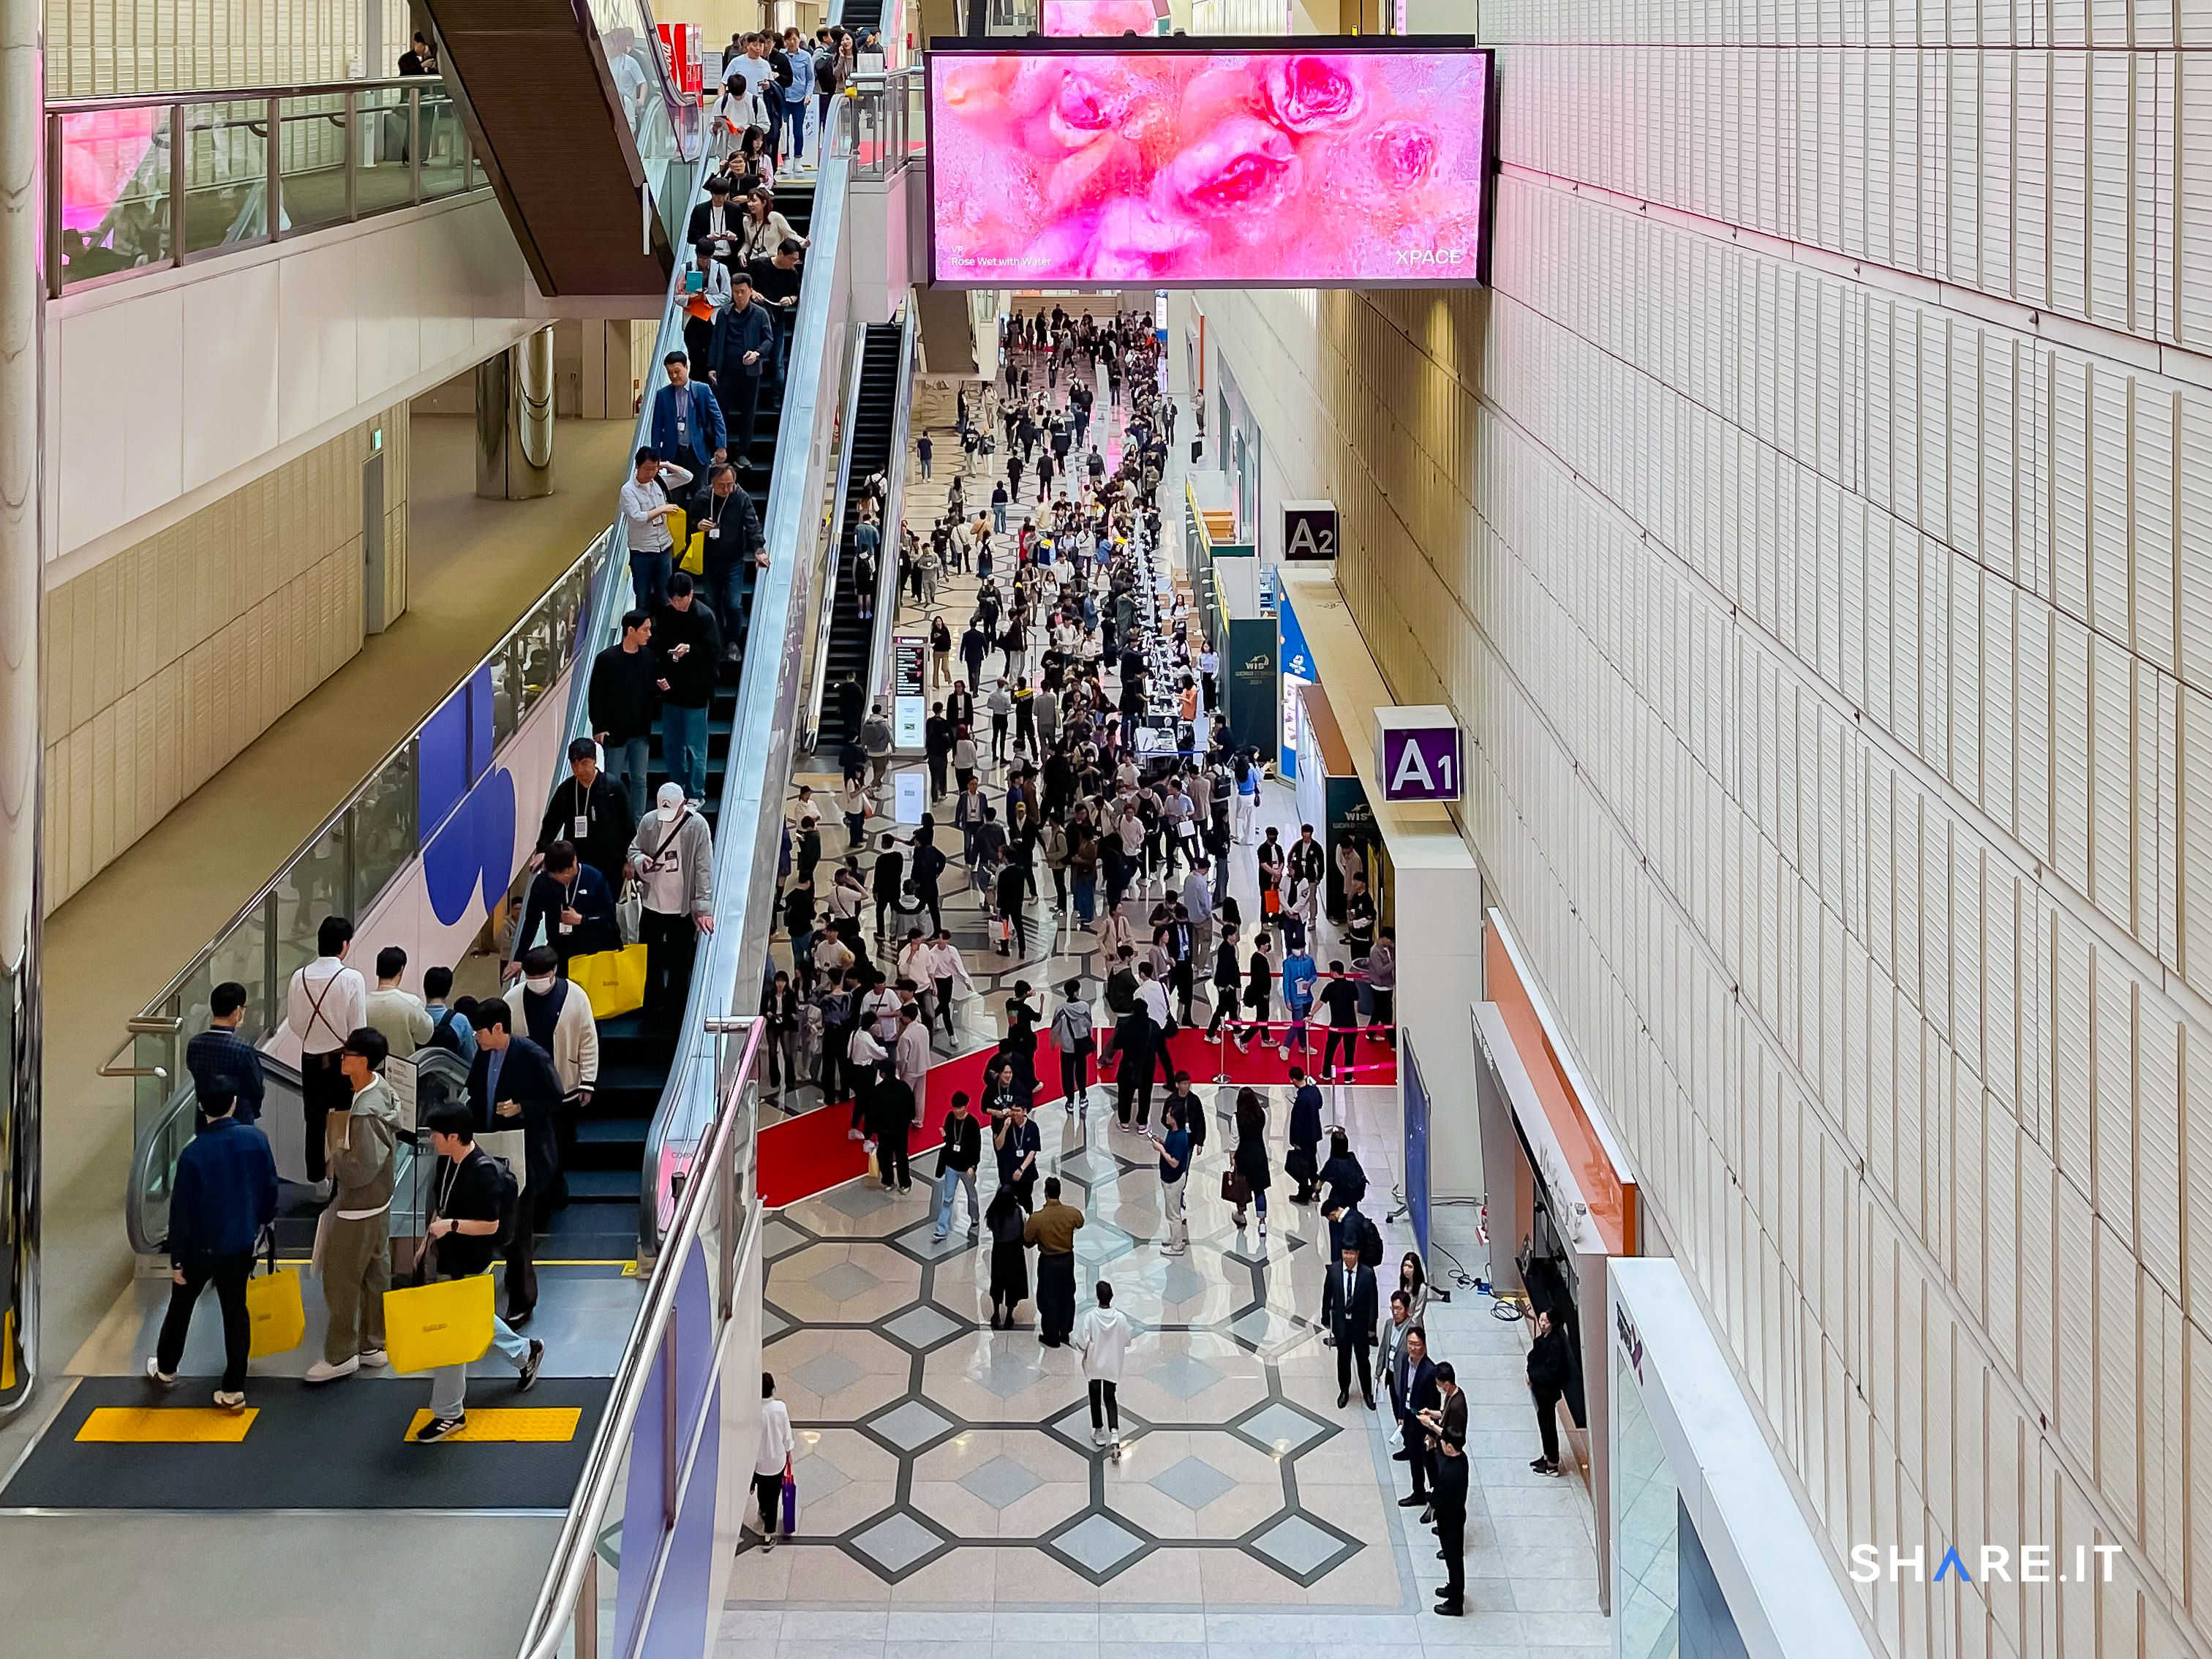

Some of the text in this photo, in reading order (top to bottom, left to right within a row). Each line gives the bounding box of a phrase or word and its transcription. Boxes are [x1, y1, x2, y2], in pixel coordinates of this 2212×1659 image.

[951, 257, 1052, 266] Rose Wet with Water
[1395, 249, 1462, 265] XPACE
[1288, 518, 1333, 554] A2
[1391, 739, 1452, 791] A1
